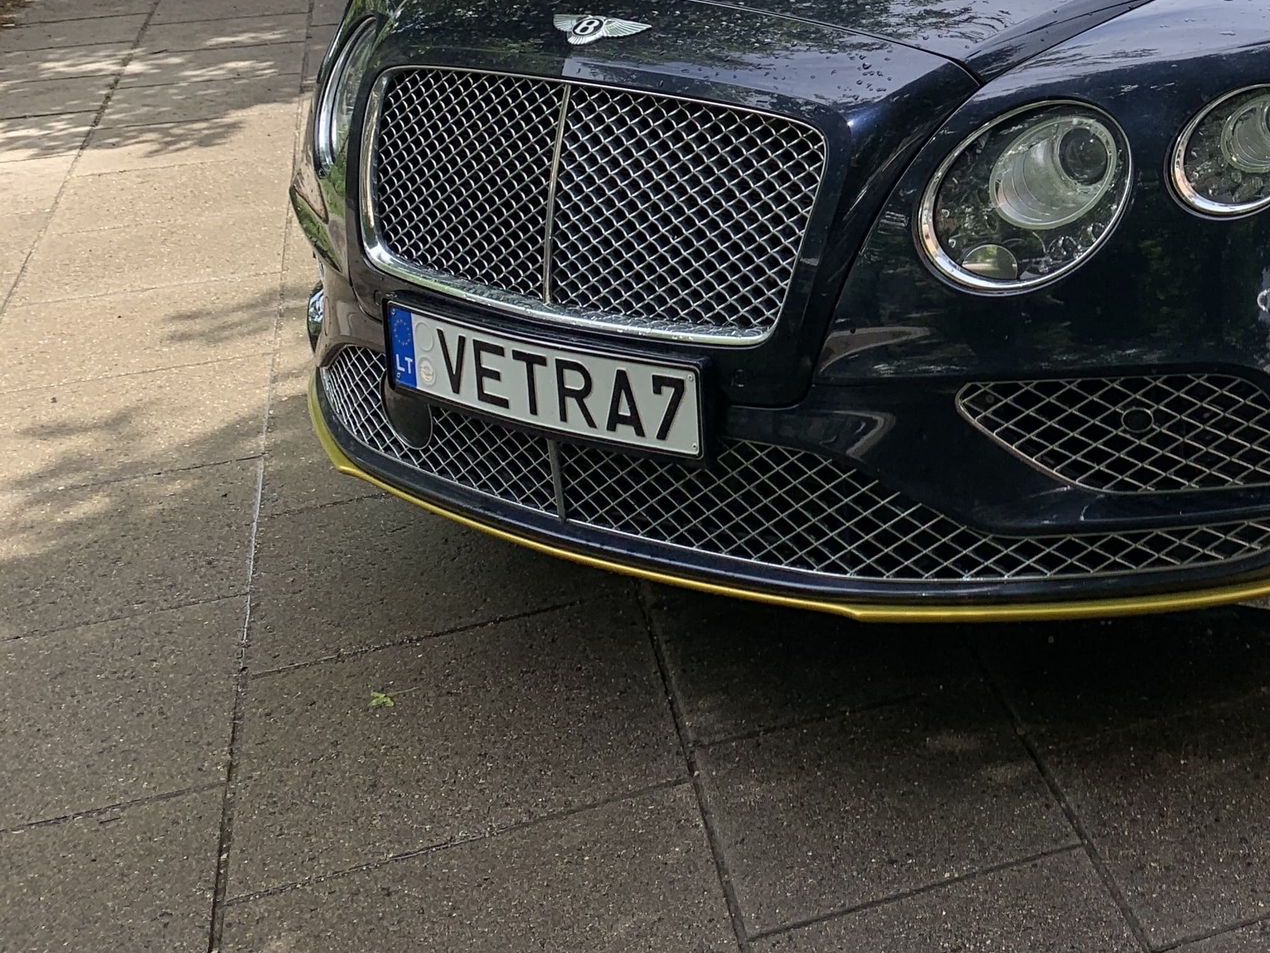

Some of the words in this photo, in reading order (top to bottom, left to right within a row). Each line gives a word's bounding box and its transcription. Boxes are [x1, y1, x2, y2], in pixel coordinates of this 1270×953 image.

[574, 19, 600, 35] B
[396, 354, 413, 374] LT
[437, 329, 685, 441] VETRA7
